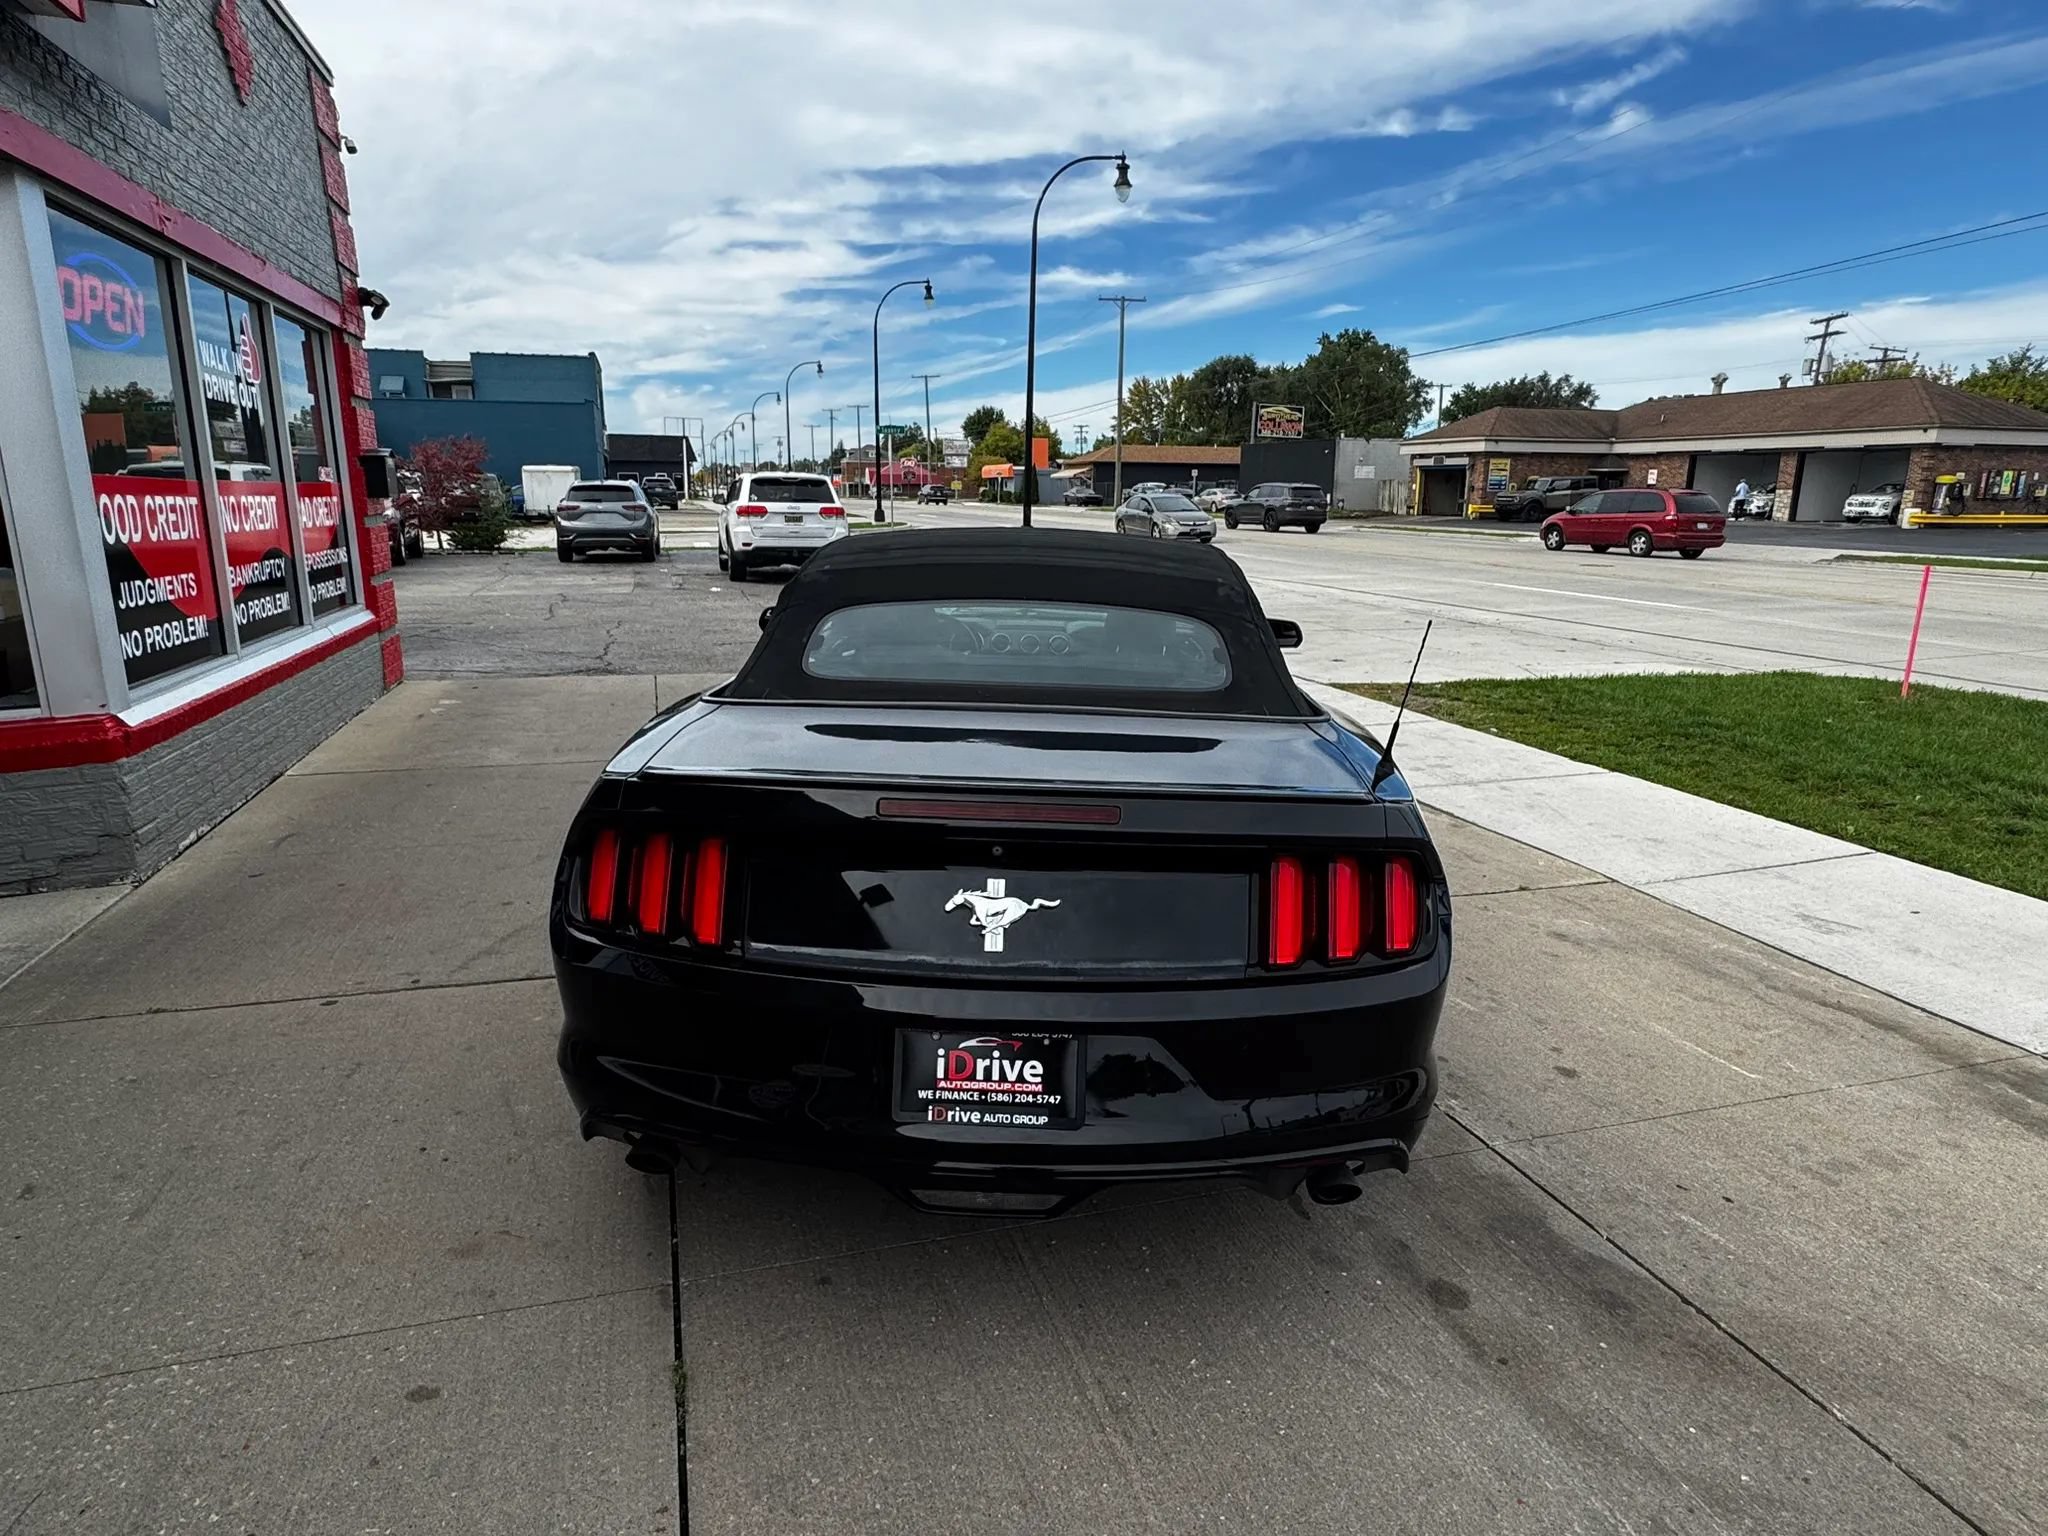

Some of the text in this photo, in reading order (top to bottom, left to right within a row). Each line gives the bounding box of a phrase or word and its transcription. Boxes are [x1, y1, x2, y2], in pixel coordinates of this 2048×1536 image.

[57, 266, 145, 338] OPEN
[199, 339, 243, 376] WALK IN
[204, 373, 258, 410] DRIVE OUT
[903, 459, 915, 468] DQ
[99, 493, 200, 545] OOD CREDIT
[219, 495, 279, 533] NO CREDIT
[300, 496, 340, 529] AD CREDIT
[229, 557, 286, 588] BANKRUPTCY
[304, 546, 348, 572] EPOSSESSIONS
[118, 572, 197, 609] JUDGMENTS
[309, 576, 348, 603] O PROBLEM!
[233, 591, 291, 626] NO PROBLEM!
[120, 614, 209, 660] NO PROBLEM!
[936, 1048, 1043, 1083] iDrive
[918, 1090, 1062, 1104] WE FINANCE (586) 204-5747
[937, 1081, 1043, 1092] AUTOGROUP.COM
[927, 1105, 1049, 1125] iDrive AUTO GROUP
